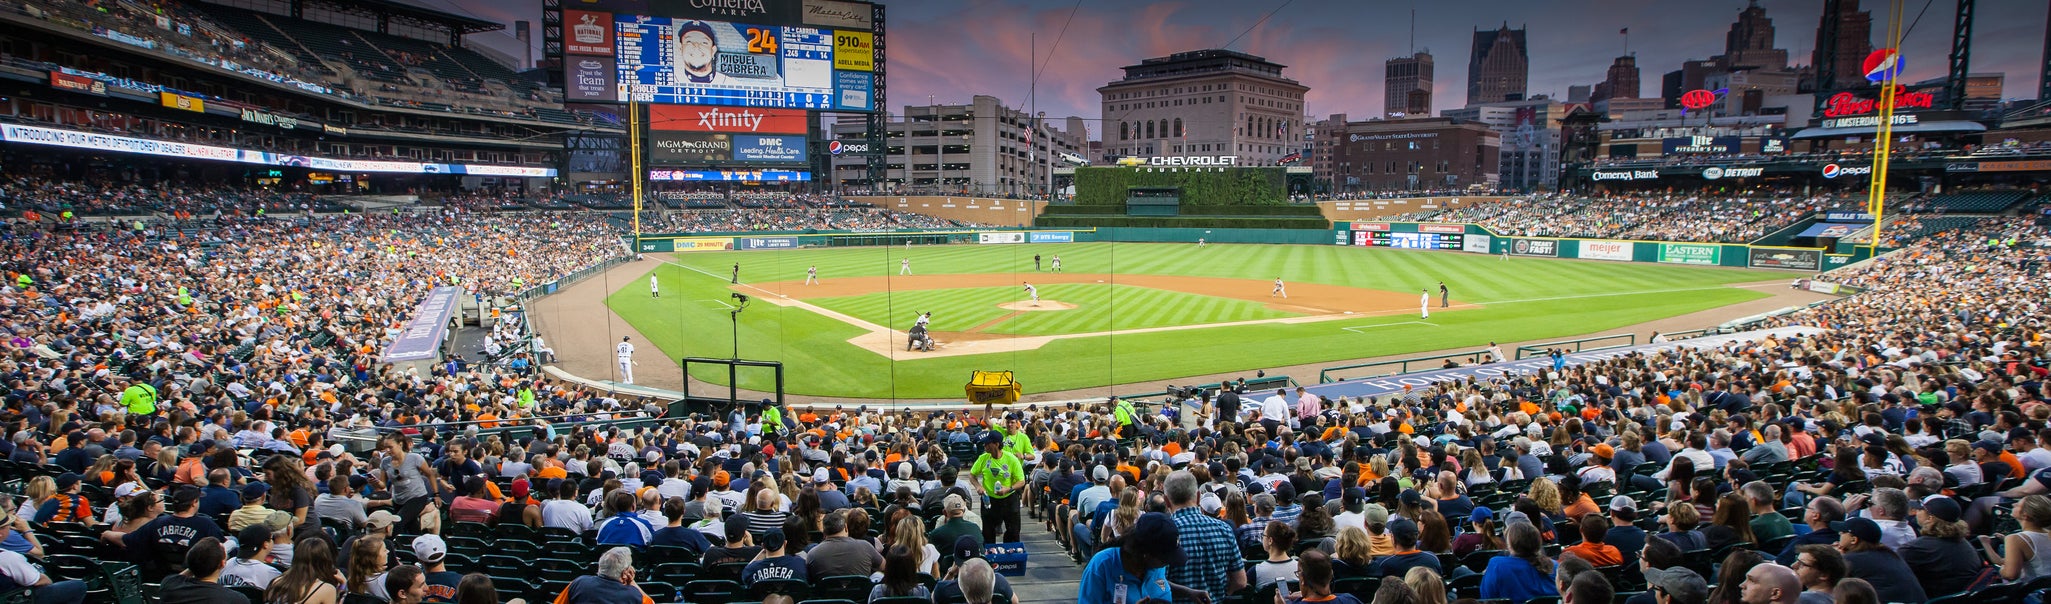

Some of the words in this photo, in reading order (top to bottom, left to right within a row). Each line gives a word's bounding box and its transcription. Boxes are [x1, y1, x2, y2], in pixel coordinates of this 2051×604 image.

[711, 7, 747, 17] PARK
[577, 28, 602, 37] NATIONAL
[746, 28, 778, 54] 24
[838, 36, 860, 47] 910
[720, 54, 757, 65] MIGUEL
[720, 63, 767, 76] CABRERA
[577, 74, 605, 85] Team
[822, 95, 829, 103] 2
[1682, 91, 1715, 107] AAA
[1824, 92, 1875, 118] PEPSI
[241, 108, 254, 122] JACK
[254, 110, 274, 125] DANIEL'S
[698, 107, 764, 131] xfinity
[1821, 119, 1836, 128] NEW
[1836, 116, 1882, 128] AMSTERDAM
[9, 127, 65, 143] INTRODUCING
[66, 133, 86, 144] YOUR
[88, 135, 111, 147] METRO
[112, 138, 140, 149] DETROIT
[140, 141, 160, 152] CHEVY
[161, 143, 186, 154] DEALERS
[657, 140, 681, 149] MGM
[694, 141, 728, 150] GRAND
[759, 138, 783, 148] DMC
[740, 147, 764, 155] Leading.
[786, 147, 801, 155] Care.
[843, 143, 868, 154] pepsi
[1151, 156, 1238, 166] CHEVROLET
[1634, 169, 1659, 179] Bank
[1724, 168, 1763, 178] DETROIT
[1839, 166, 1871, 176] pepsi
[750, 239, 765, 248] Lite
[1589, 242, 1621, 254] meijer
[1529, 246, 1554, 254] FAST!
[1665, 244, 1714, 255] EASTERN
[621, 346, 628, 354] 41
[1363, 372, 1471, 392] HOME
[157, 525, 197, 539] CABRERA
[753, 566, 793, 583] CABRERA
